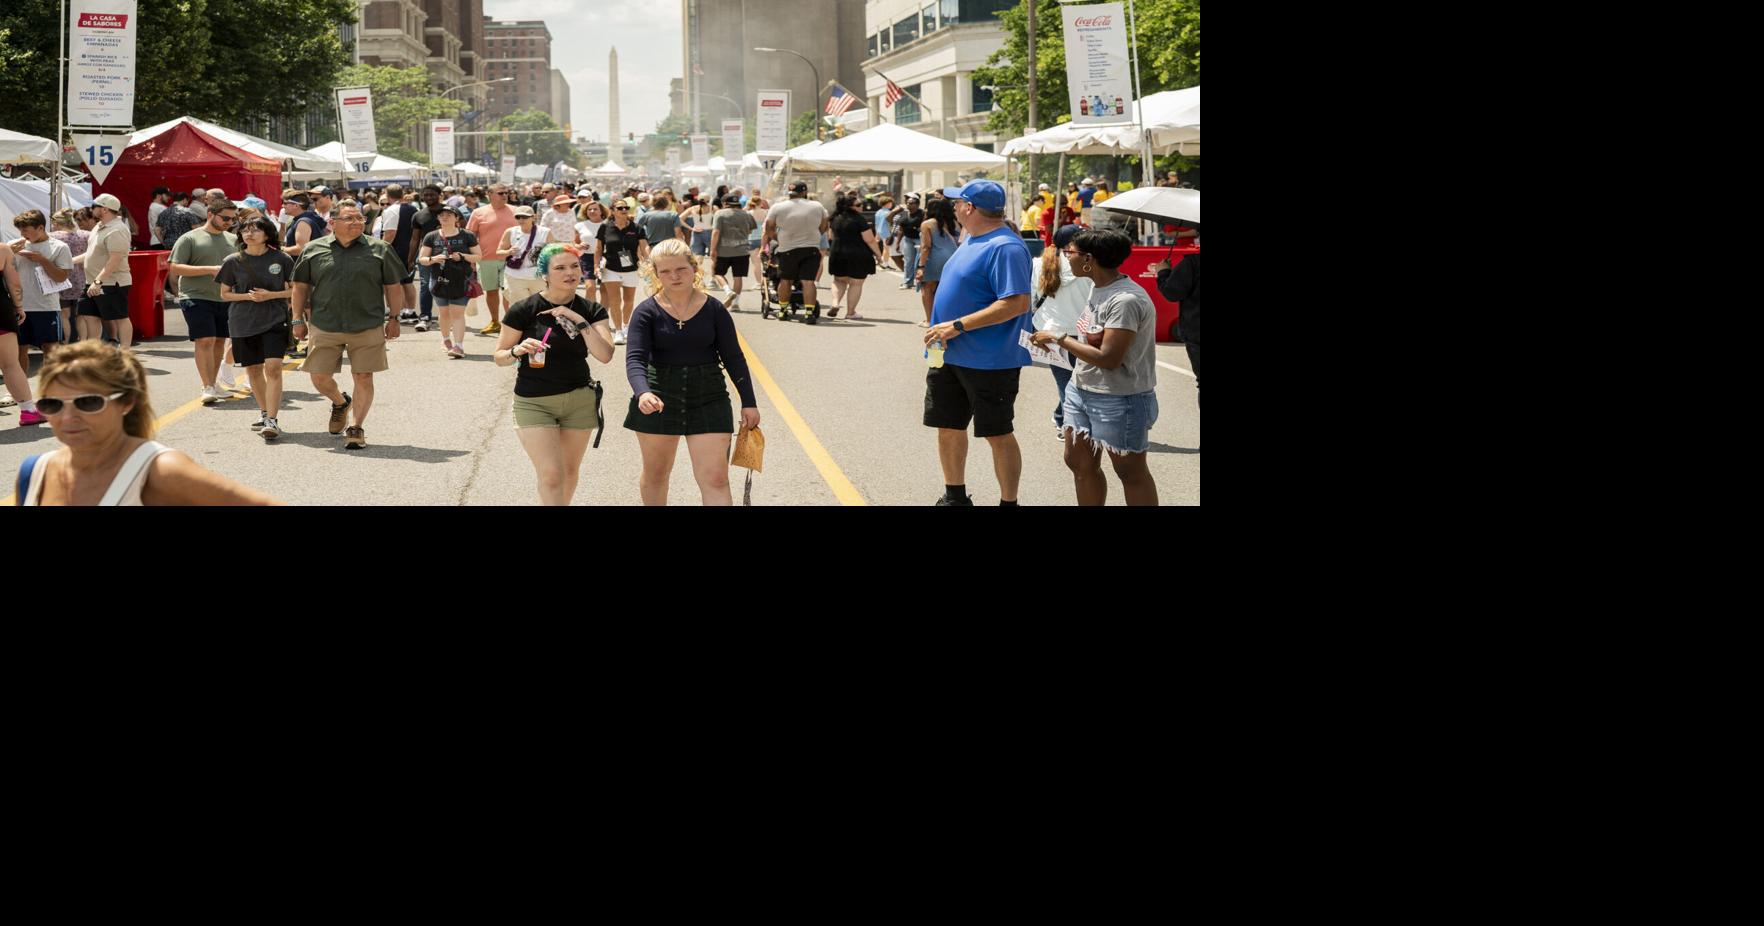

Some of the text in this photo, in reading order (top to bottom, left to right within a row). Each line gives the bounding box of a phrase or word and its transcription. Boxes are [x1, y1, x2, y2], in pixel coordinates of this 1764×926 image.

[86, 145, 114, 166] 15
[355, 162, 369, 172] 16
[764, 160, 776, 169] 17
